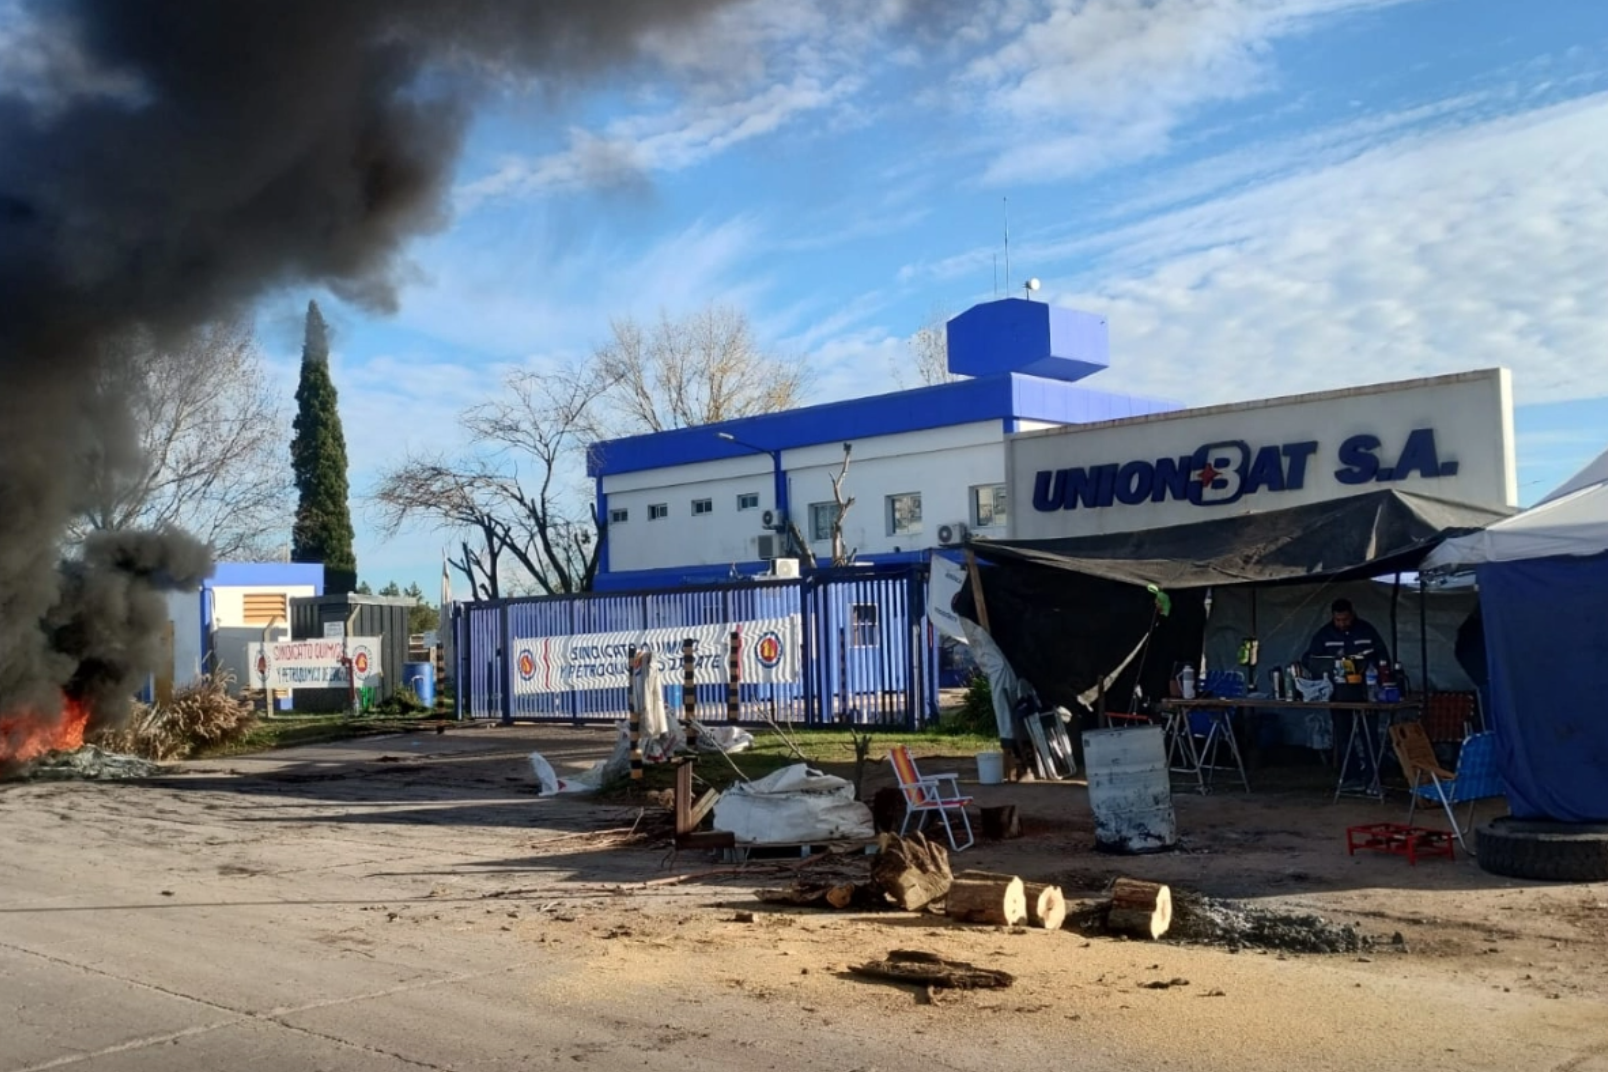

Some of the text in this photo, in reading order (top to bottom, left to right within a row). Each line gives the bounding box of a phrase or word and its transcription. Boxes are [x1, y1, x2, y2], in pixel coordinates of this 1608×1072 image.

[1032, 427, 1459, 513] UNIONBAT S.A.
[641, 639, 699, 656] QUIMIO
[568, 660, 666, 679] PETROQUIS
[669, 654, 721, 671] ZAATE
